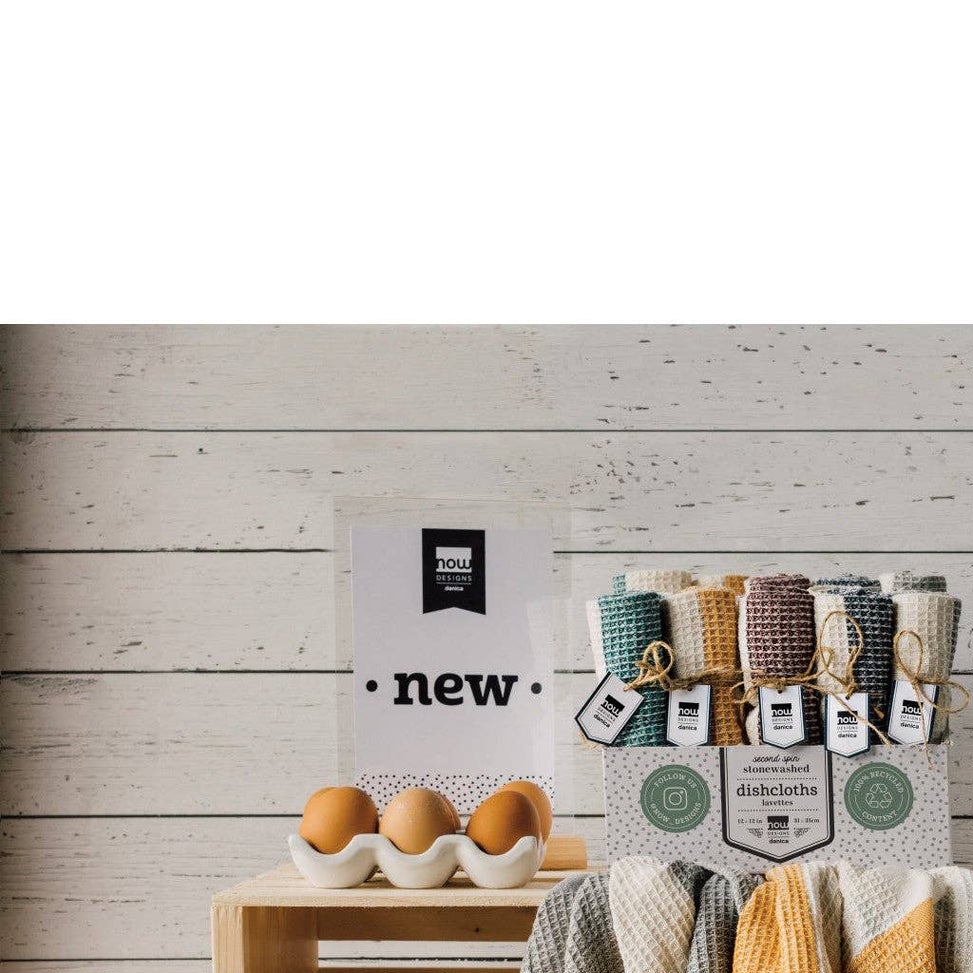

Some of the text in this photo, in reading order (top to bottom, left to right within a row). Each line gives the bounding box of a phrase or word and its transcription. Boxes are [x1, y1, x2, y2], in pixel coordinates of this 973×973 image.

[436, 558, 472, 569] now
[436, 574, 472, 582] DESIGNS
[394, 672, 519, 706] new
[602, 699, 620, 716] now
[678, 708, 699, 716] now
[771, 708, 793, 717] now
[837, 715, 858, 724] now
[753, 754, 800, 764] second spin
[743, 764, 810, 774] stonewashed
[654, 773, 687, 787] FOLLOW
[736, 783, 818, 797] dishcloths
[862, 810, 898, 822] CONTENT
